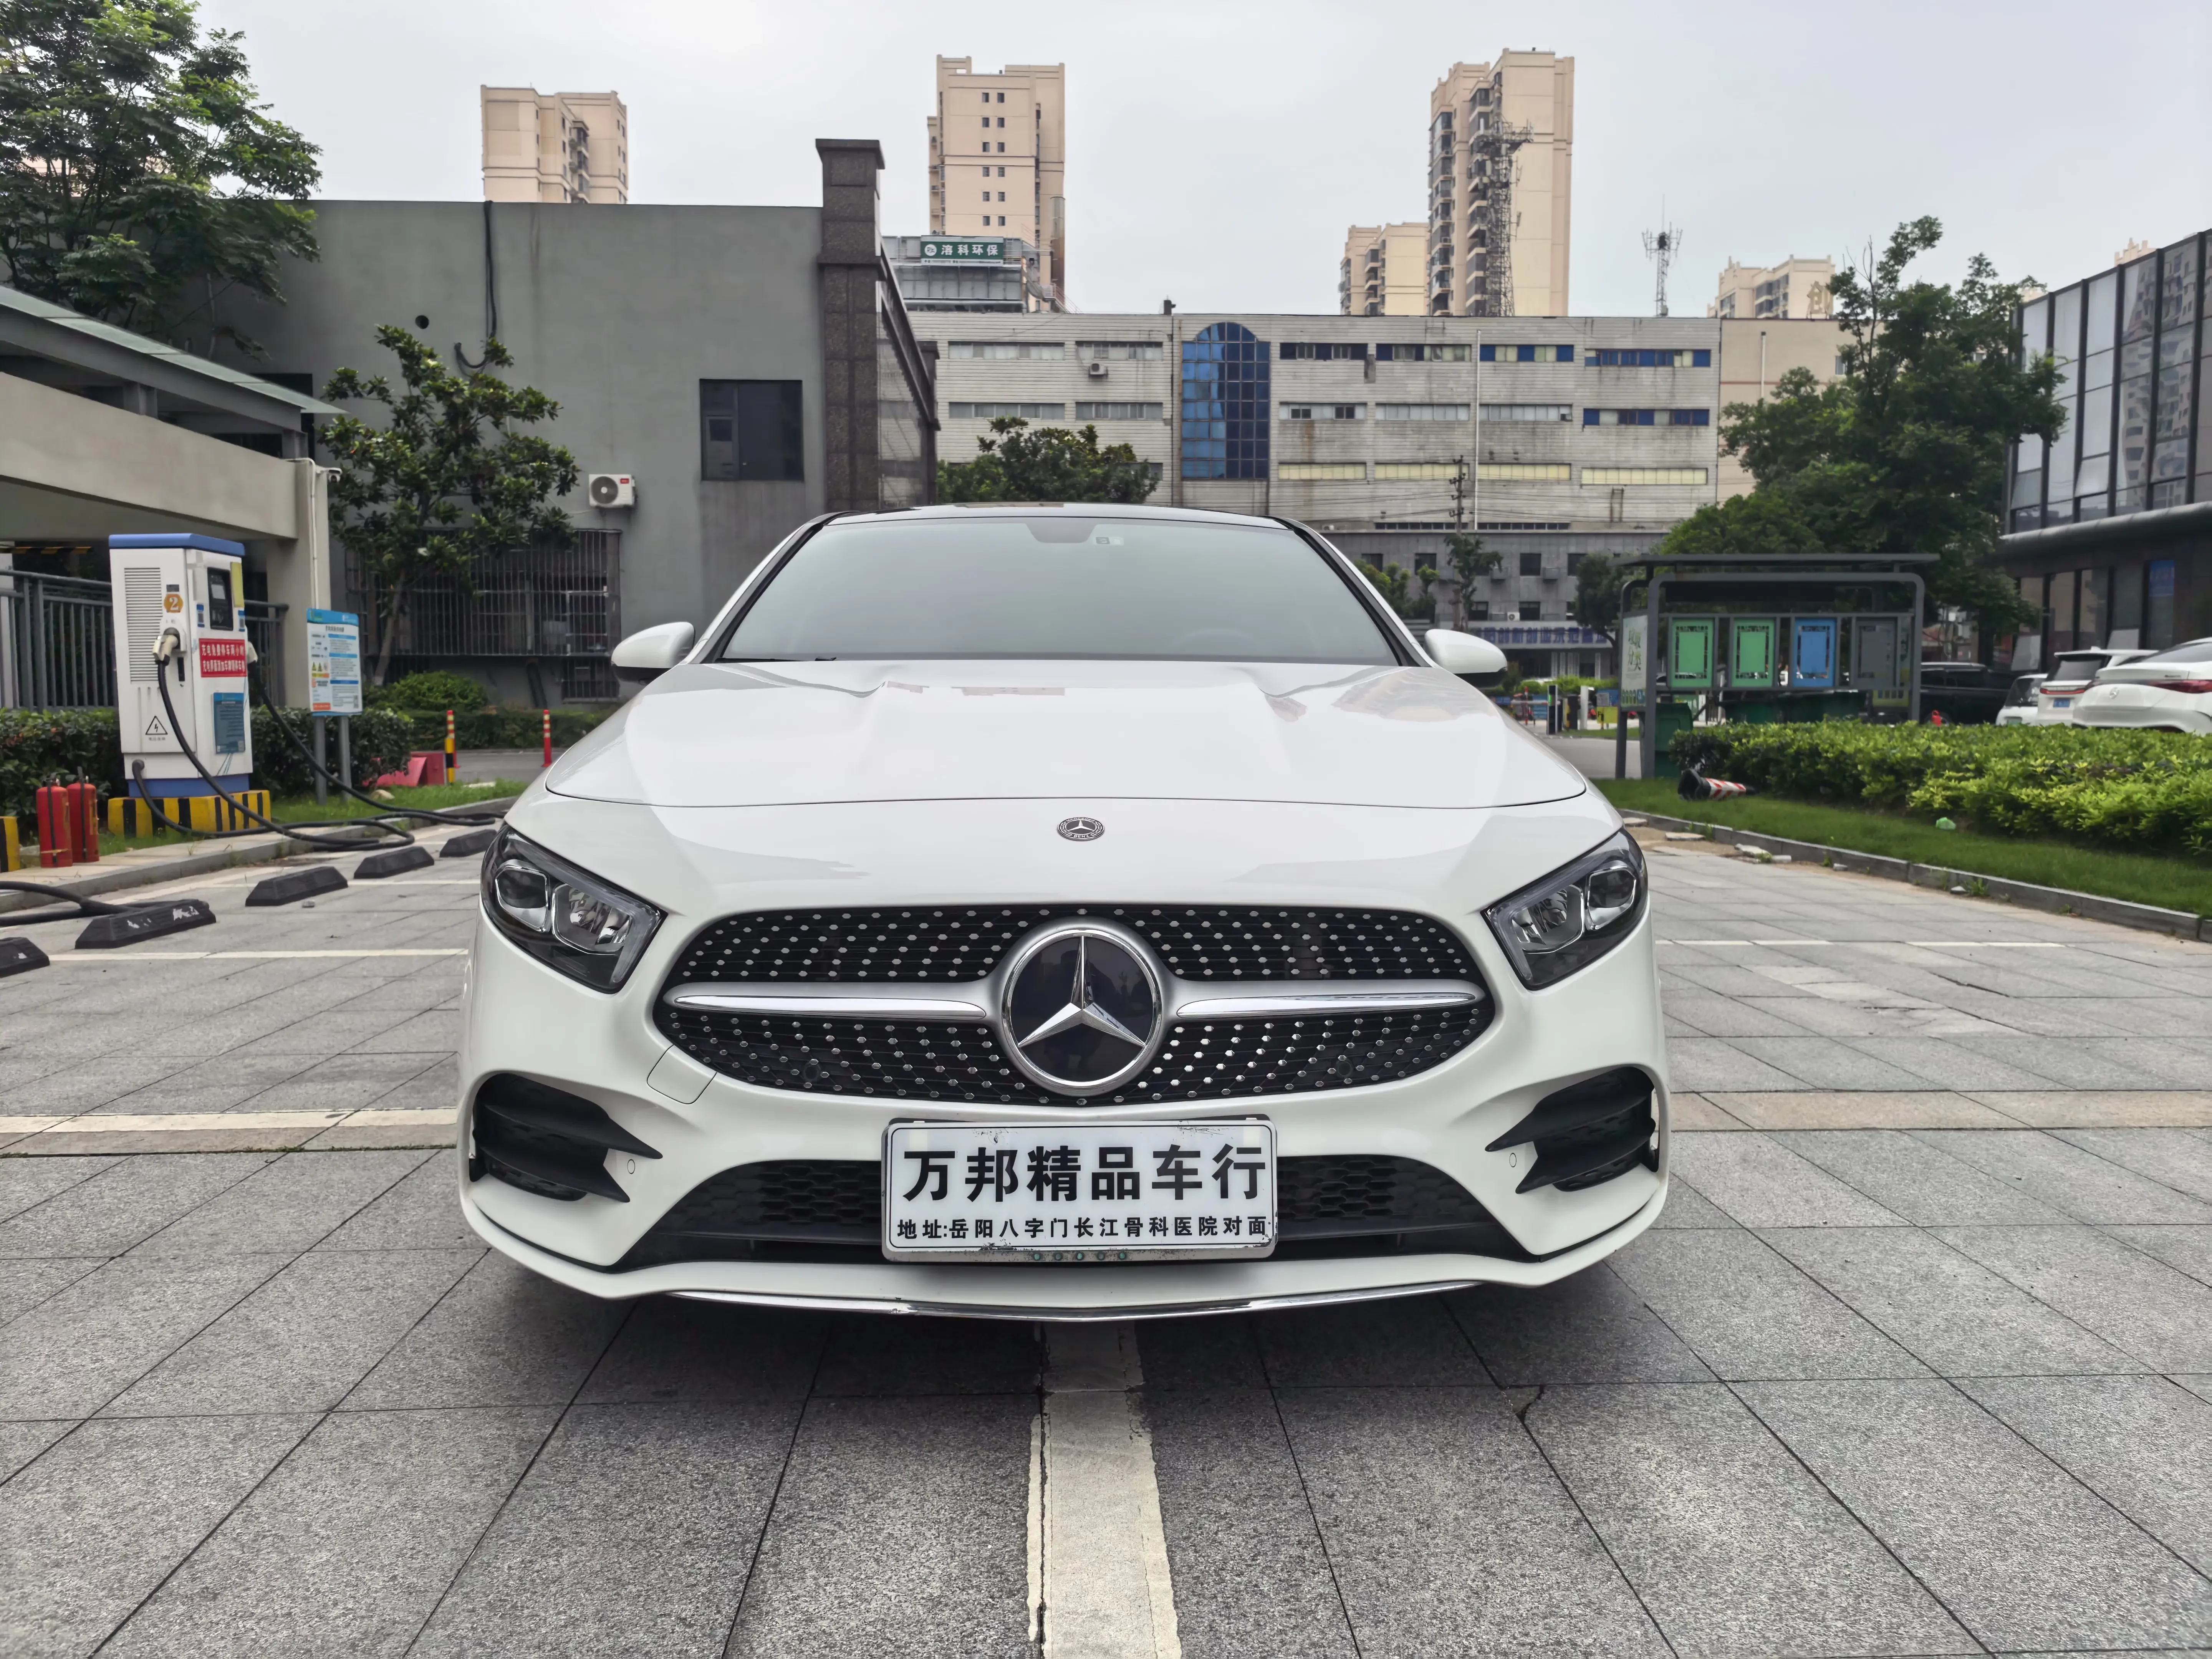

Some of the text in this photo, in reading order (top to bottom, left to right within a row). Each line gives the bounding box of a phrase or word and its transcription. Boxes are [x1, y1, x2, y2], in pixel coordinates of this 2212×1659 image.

[169, 597, 179, 611] 2
[902, 1144, 1266, 1202] 万邦精品车行
[897, 1216, 1267, 1239] 地址:岳阳八字门长江骨科医院对面
